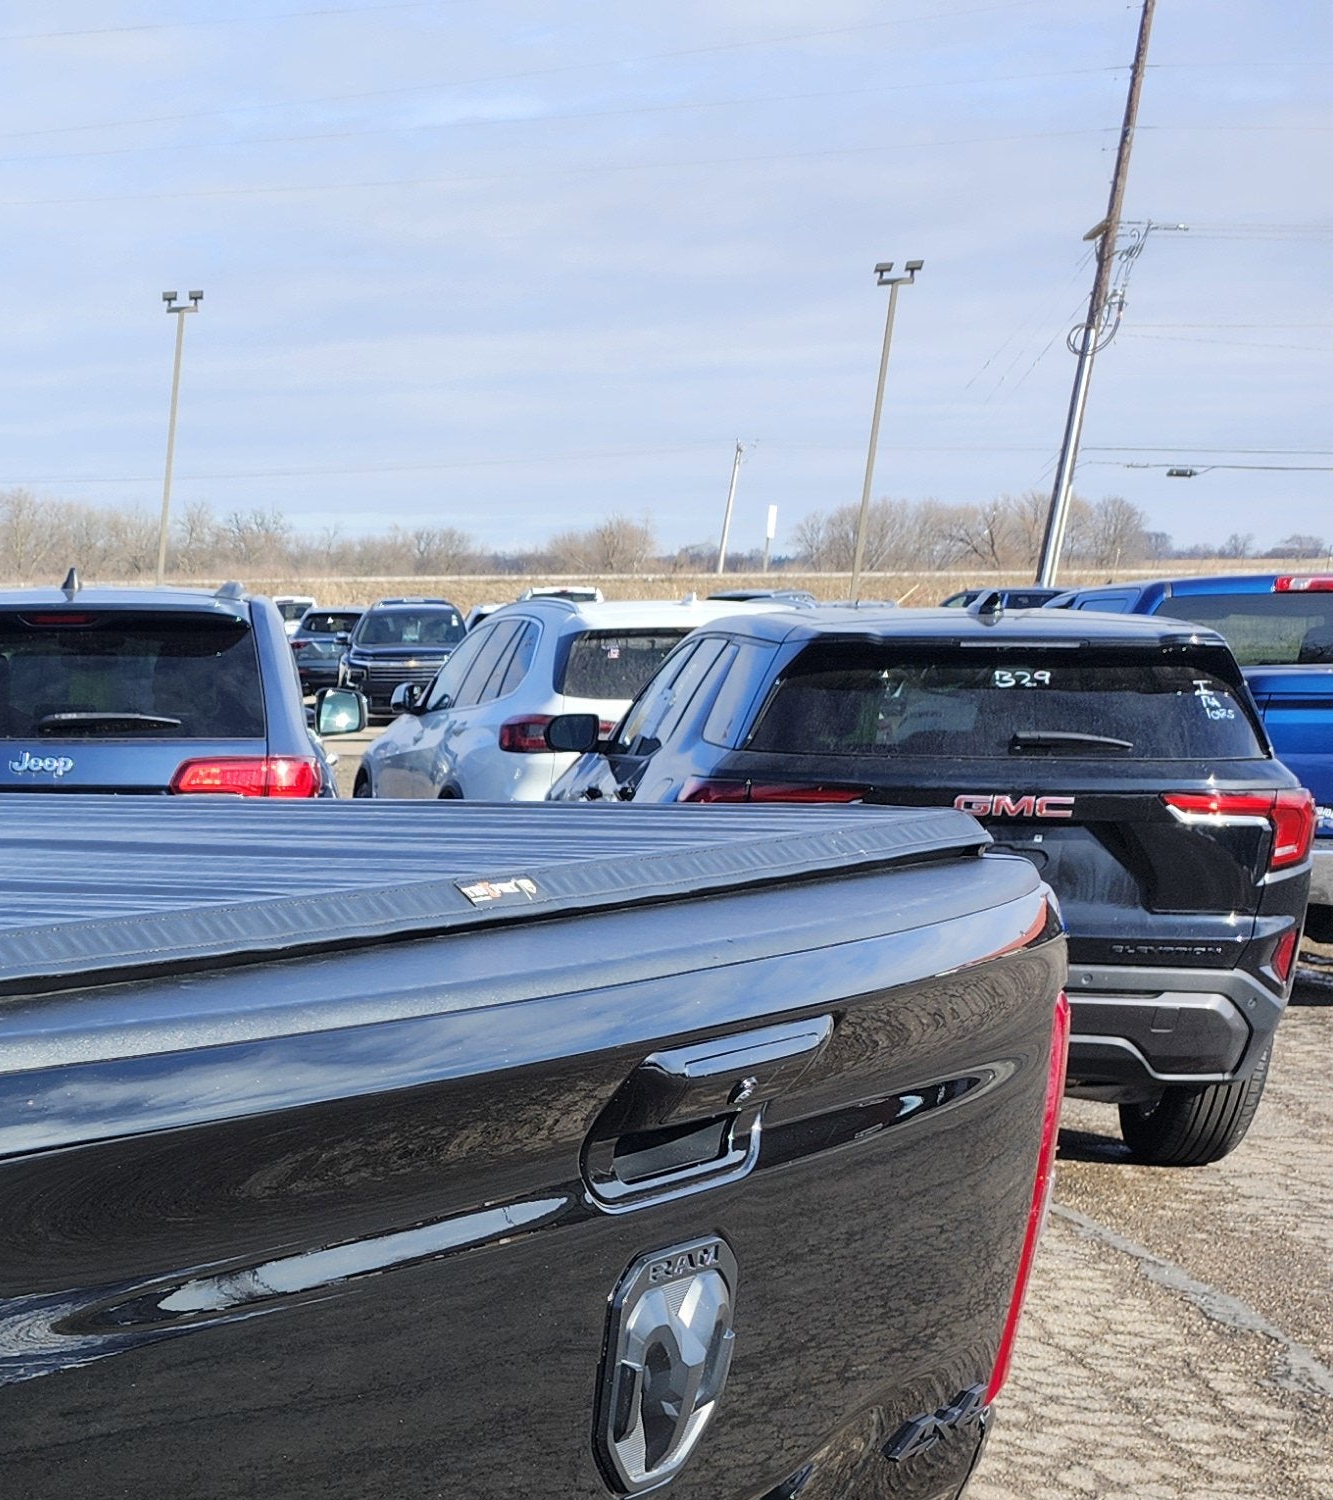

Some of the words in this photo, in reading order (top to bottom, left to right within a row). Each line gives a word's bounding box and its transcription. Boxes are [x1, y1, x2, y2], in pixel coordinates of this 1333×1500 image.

[994, 670, 1051, 688] B29
[9, 750, 73, 777] Jeep
[954, 794, 1075, 817] GMC
[649, 1244, 719, 1282] RAM
